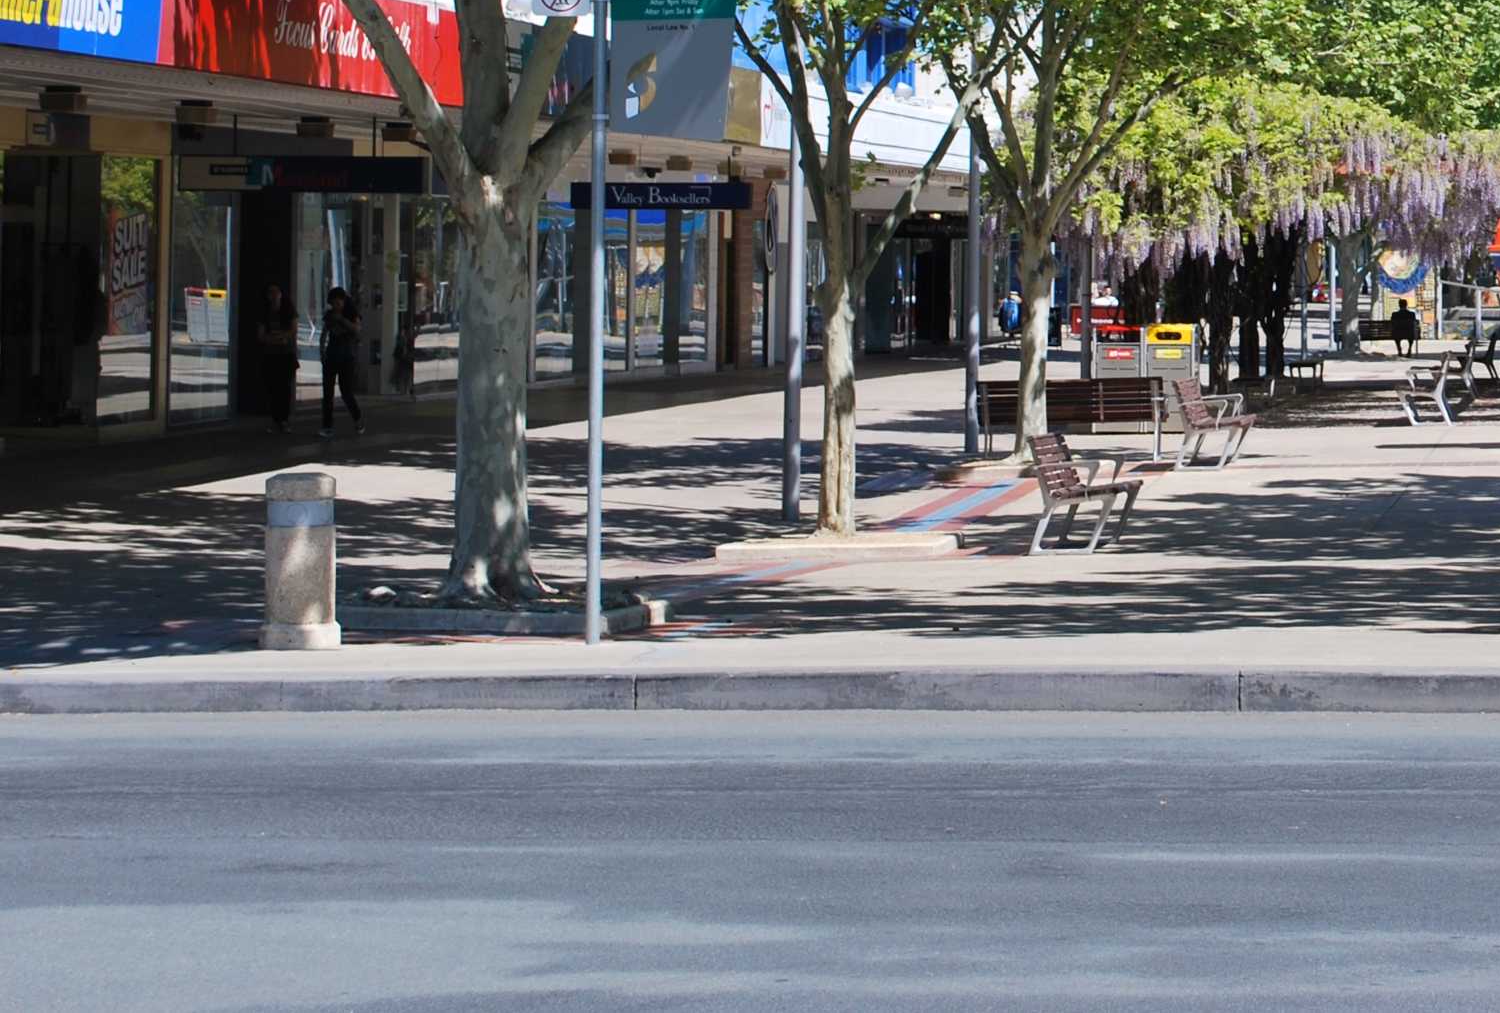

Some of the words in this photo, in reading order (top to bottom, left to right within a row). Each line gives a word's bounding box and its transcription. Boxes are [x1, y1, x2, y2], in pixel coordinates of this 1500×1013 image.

[319, 2, 360, 59] Cards
[611, 185, 642, 205] Valley
[648, 185, 711, 204] Booksellers
[114, 213, 146, 254] SUIT
[112, 250, 146, 292] SALE
